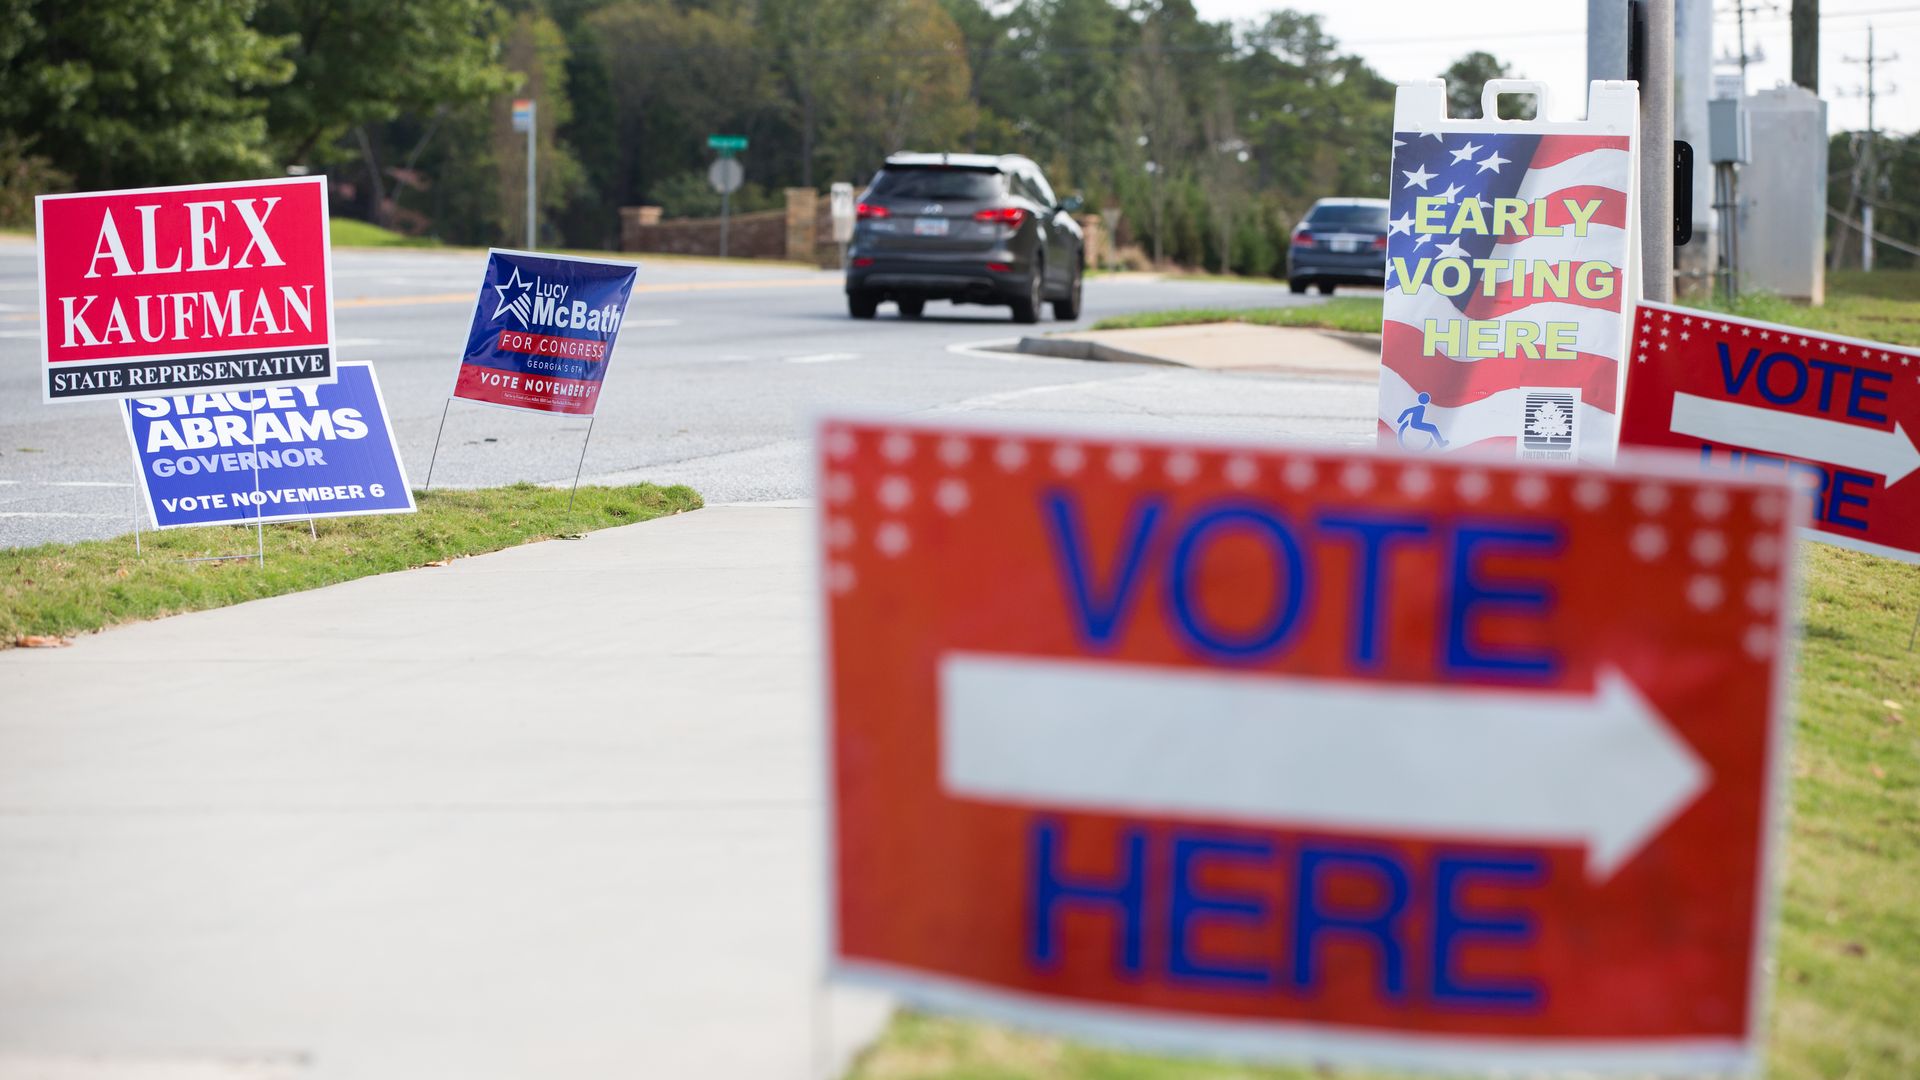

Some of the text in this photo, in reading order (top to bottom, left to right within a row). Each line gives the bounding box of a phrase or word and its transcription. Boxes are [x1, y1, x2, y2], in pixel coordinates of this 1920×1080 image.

[84, 196, 286, 278] ALEX
[1414, 196, 1603, 238] EARLY
[535, 275, 568, 304] Lucy
[1392, 257, 1615, 300] VOTING
[58, 285, 314, 348] KAUFMAN
[532, 296, 622, 333] McBath
[501, 334, 605, 358] FOR CONGRESS
[1422, 318, 1579, 360] HERE
[54, 354, 324, 392] STATE REPRESENTATIVE
[480, 372, 519, 389] VOTE
[524, 379, 584, 398] NOVEMBER
[527, 359, 583, 374] GEORGIA'S 6TH
[1716, 341, 1893, 424] VOTE
[146, 408, 368, 453] ABRAMS
[151, 447, 328, 478] GOVERNOR
[161, 483, 385, 513] VOTE NOVEMBER 6
[1040, 487, 1565, 680] VOTE
[1028, 819, 1549, 1009] HERE
